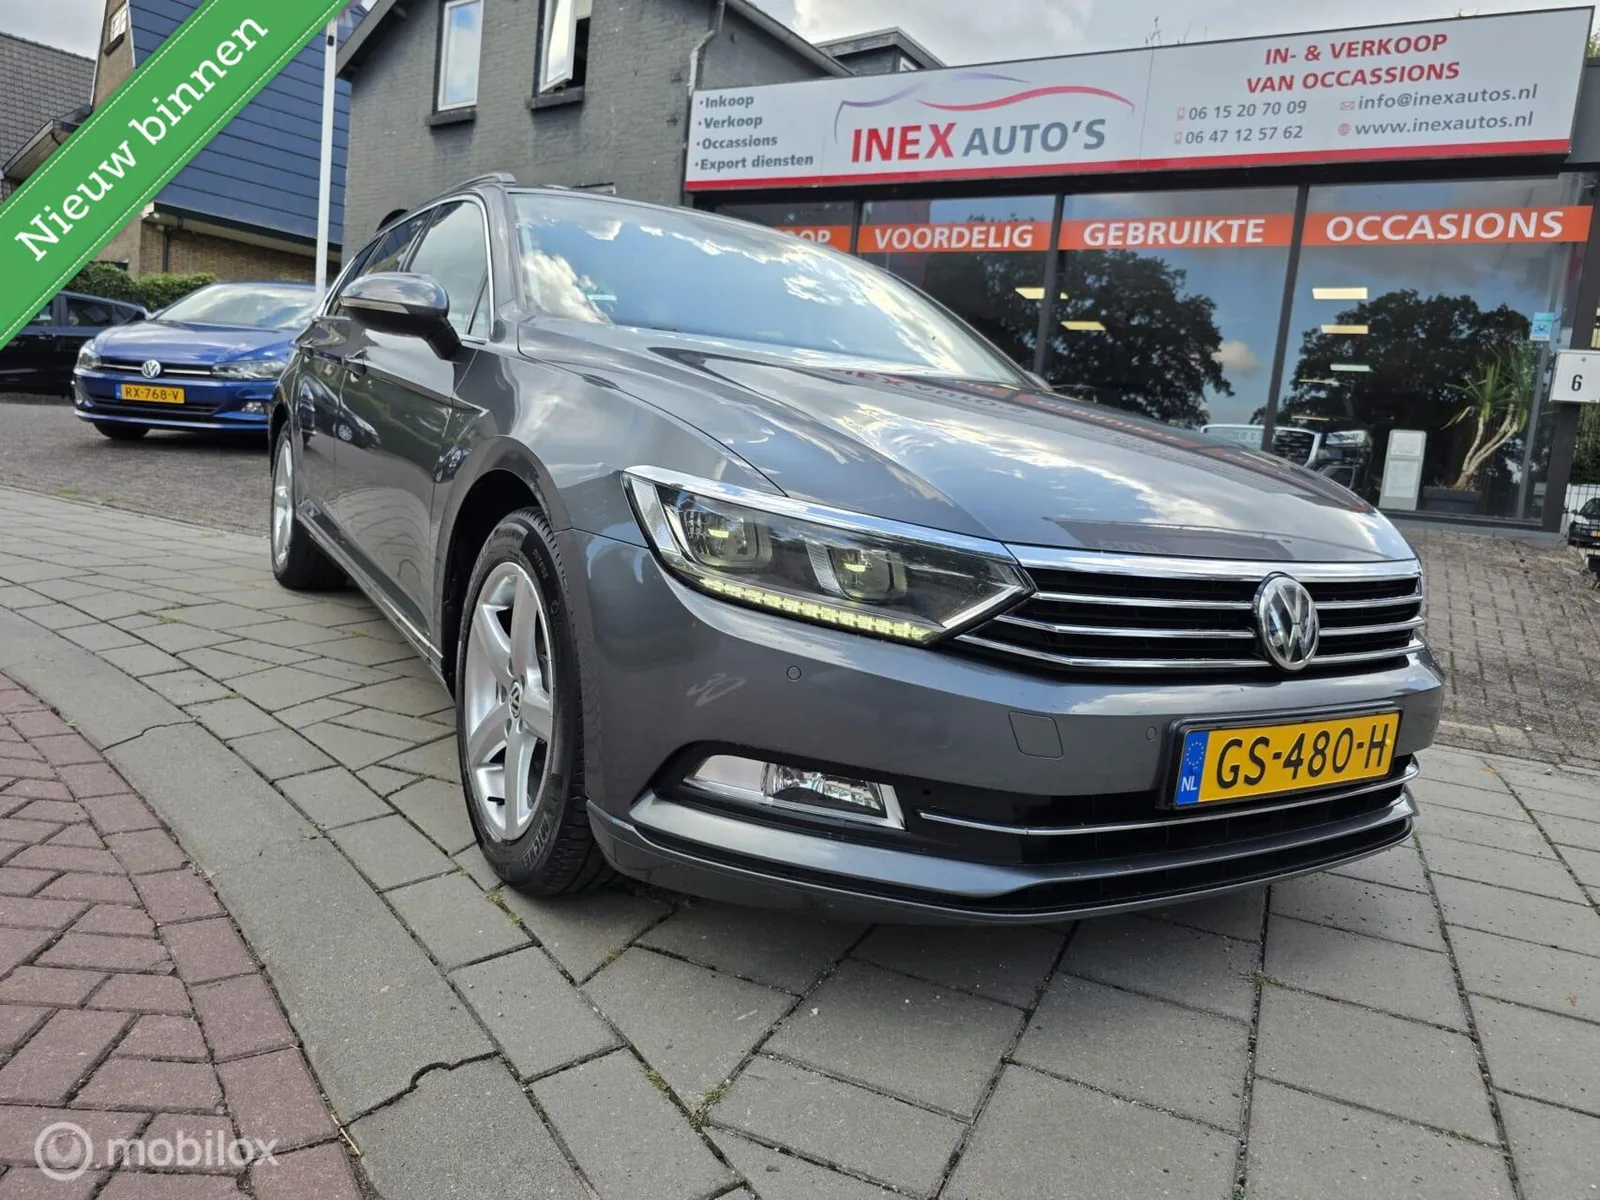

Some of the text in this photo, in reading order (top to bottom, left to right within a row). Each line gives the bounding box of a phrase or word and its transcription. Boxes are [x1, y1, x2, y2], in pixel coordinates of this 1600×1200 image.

[1264, 34, 1448, 66] IN- & VERKOOP
[1246, 62, 1460, 94] VAN OCCASSIONS
[705, 94, 754, 109] Inkoop
[1358, 84, 1538, 111] info@inexautos.nl
[1188, 100, 1307, 121] 06 15 20 70 09
[703, 115, 763, 131] Verkoop
[1355, 111, 1534, 136] www.inexautos.nl
[702, 134, 778, 150] Occassions
[851, 119, 1106, 163] INEX AUTO'S
[1185, 125, 1304, 145] 06 47 12 57 62
[700, 154, 814, 172] Export diensten
[874, 224, 1034, 250] VOORDELIG
[1083, 219, 1265, 247] GEBRUIKTE
[1325, 211, 1565, 242] OCCASIONS
[1571, 374, 1582, 392] 6
[125, 386, 179, 401] RX-768-V
[1216, 723, 1390, 789] GS-480-H
[1181, 776, 1198, 792] NL
